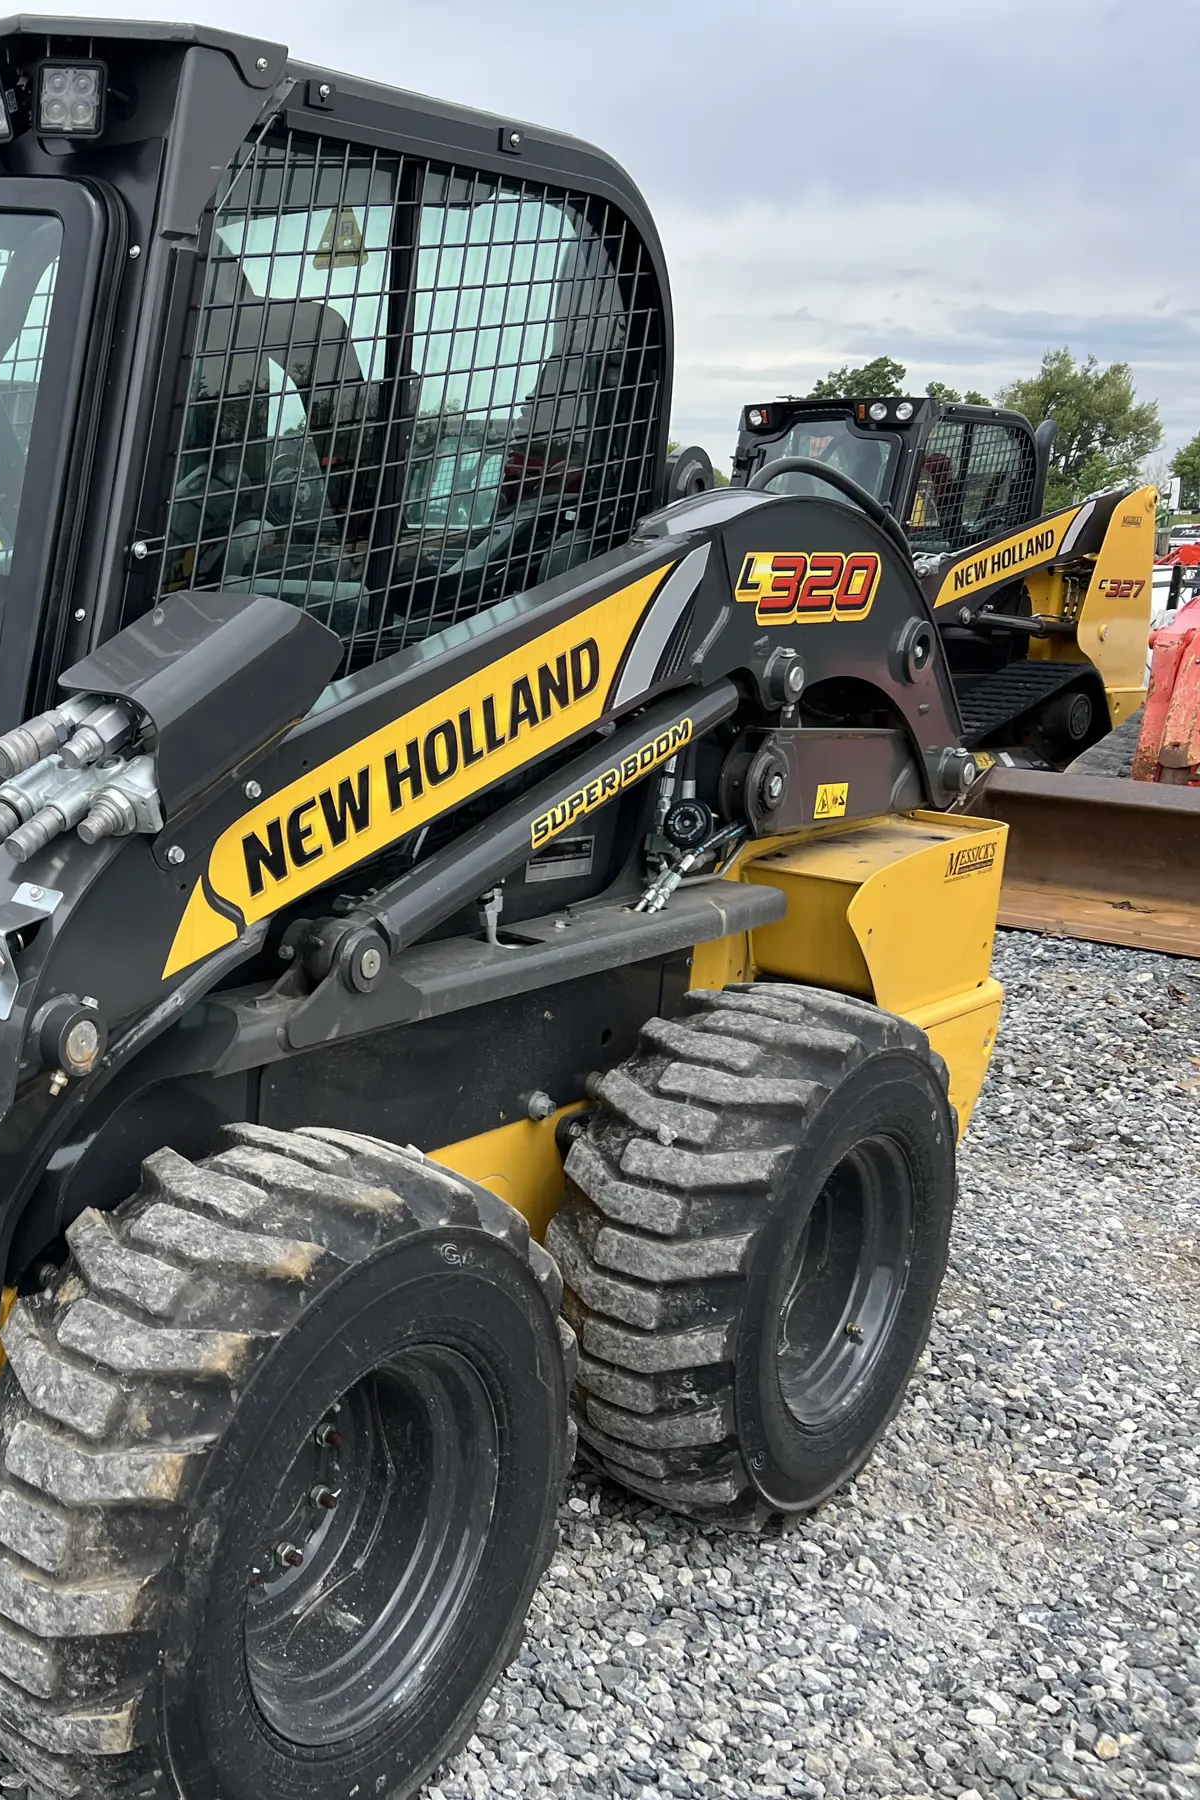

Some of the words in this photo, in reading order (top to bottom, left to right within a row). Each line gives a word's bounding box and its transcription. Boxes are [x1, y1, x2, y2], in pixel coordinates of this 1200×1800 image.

[735, 551, 883, 626] L320
[954, 555, 988, 591] NEW
[991, 529, 1055, 575] HOLLAND
[1098, 579, 1146, 598] C327
[241, 764, 372, 898] NEW
[384, 637, 601, 811] HOLLAND
[531, 769, 617, 849] SUPER
[618, 717, 693, 794] BOOM
